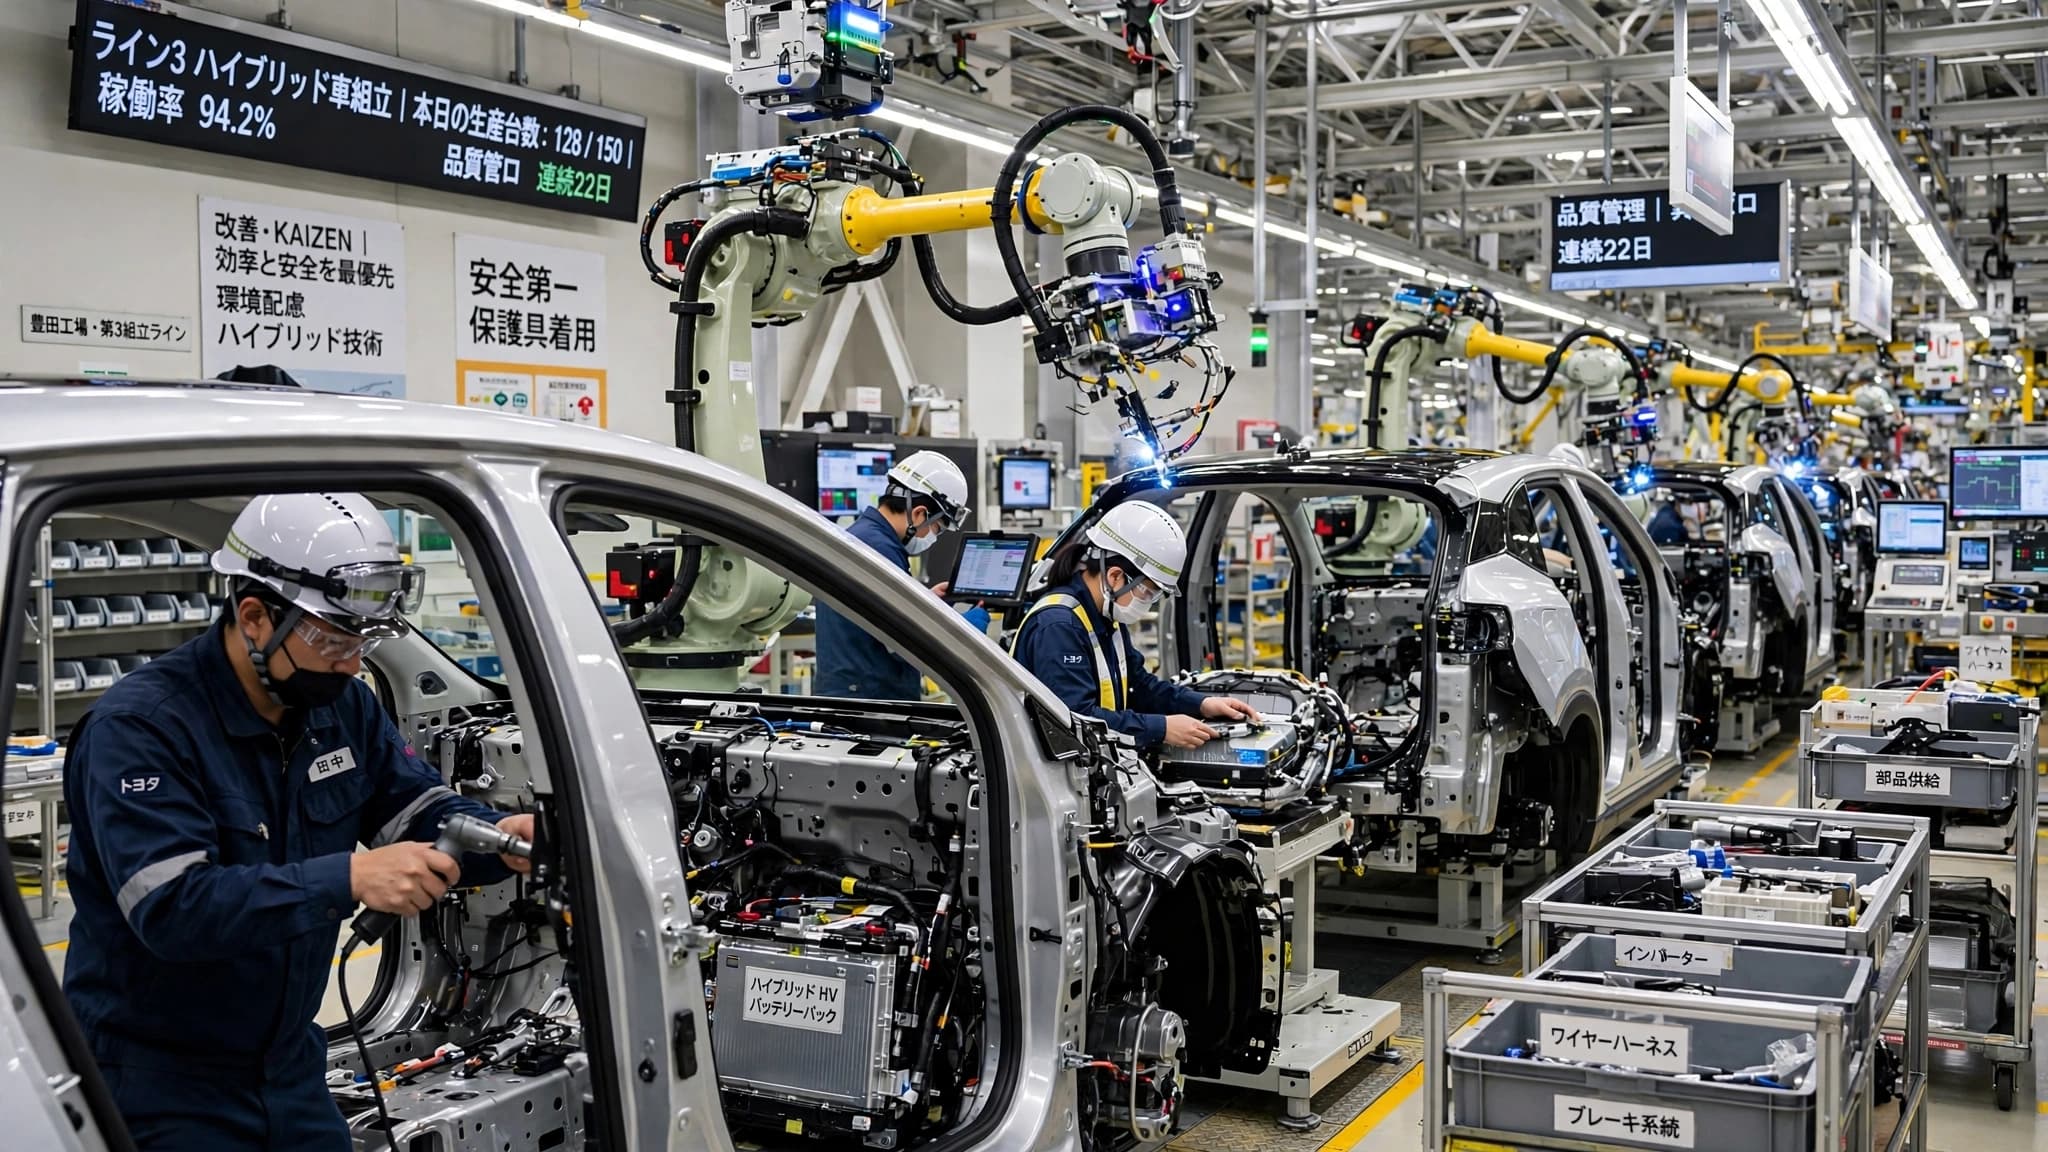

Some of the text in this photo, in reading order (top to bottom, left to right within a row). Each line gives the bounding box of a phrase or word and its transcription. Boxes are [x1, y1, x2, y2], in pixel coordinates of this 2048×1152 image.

[92, 20, 187, 75] ライン3
[193, 48, 393, 119] ハイブリッド車組立
[98, 71, 276, 139] 稼働率 94.2%
[536, 161, 611, 203] 連続22日
[1557, 199, 1646, 227] 品質管理
[215, 213, 352, 252] 改善・KAIZEN
[1558, 236, 1651, 264] 連続22日
[215, 245, 395, 289] 効率と安全を最優先
[469, 258, 578, 303] 安全第一
[216, 285, 306, 318] 環境配慮
[30, 313, 187, 341] 豊田工場・第3組立ライン
[218, 322, 383, 356] ハイブリッド技術
[469, 306, 595, 352] 保護具着用
[316, 755, 343, 774] 田中
[1875, 769, 1940, 789] 部品供給
[121, 777, 160, 794] トヨタ
[1624, 946, 1708, 966] インバーター
[750, 977, 838, 1002] ハイブリッド HV
[1551, 1027, 1678, 1057] ワイヤーハーネス
[1568, 1105, 1680, 1139] ブレーキ系統
